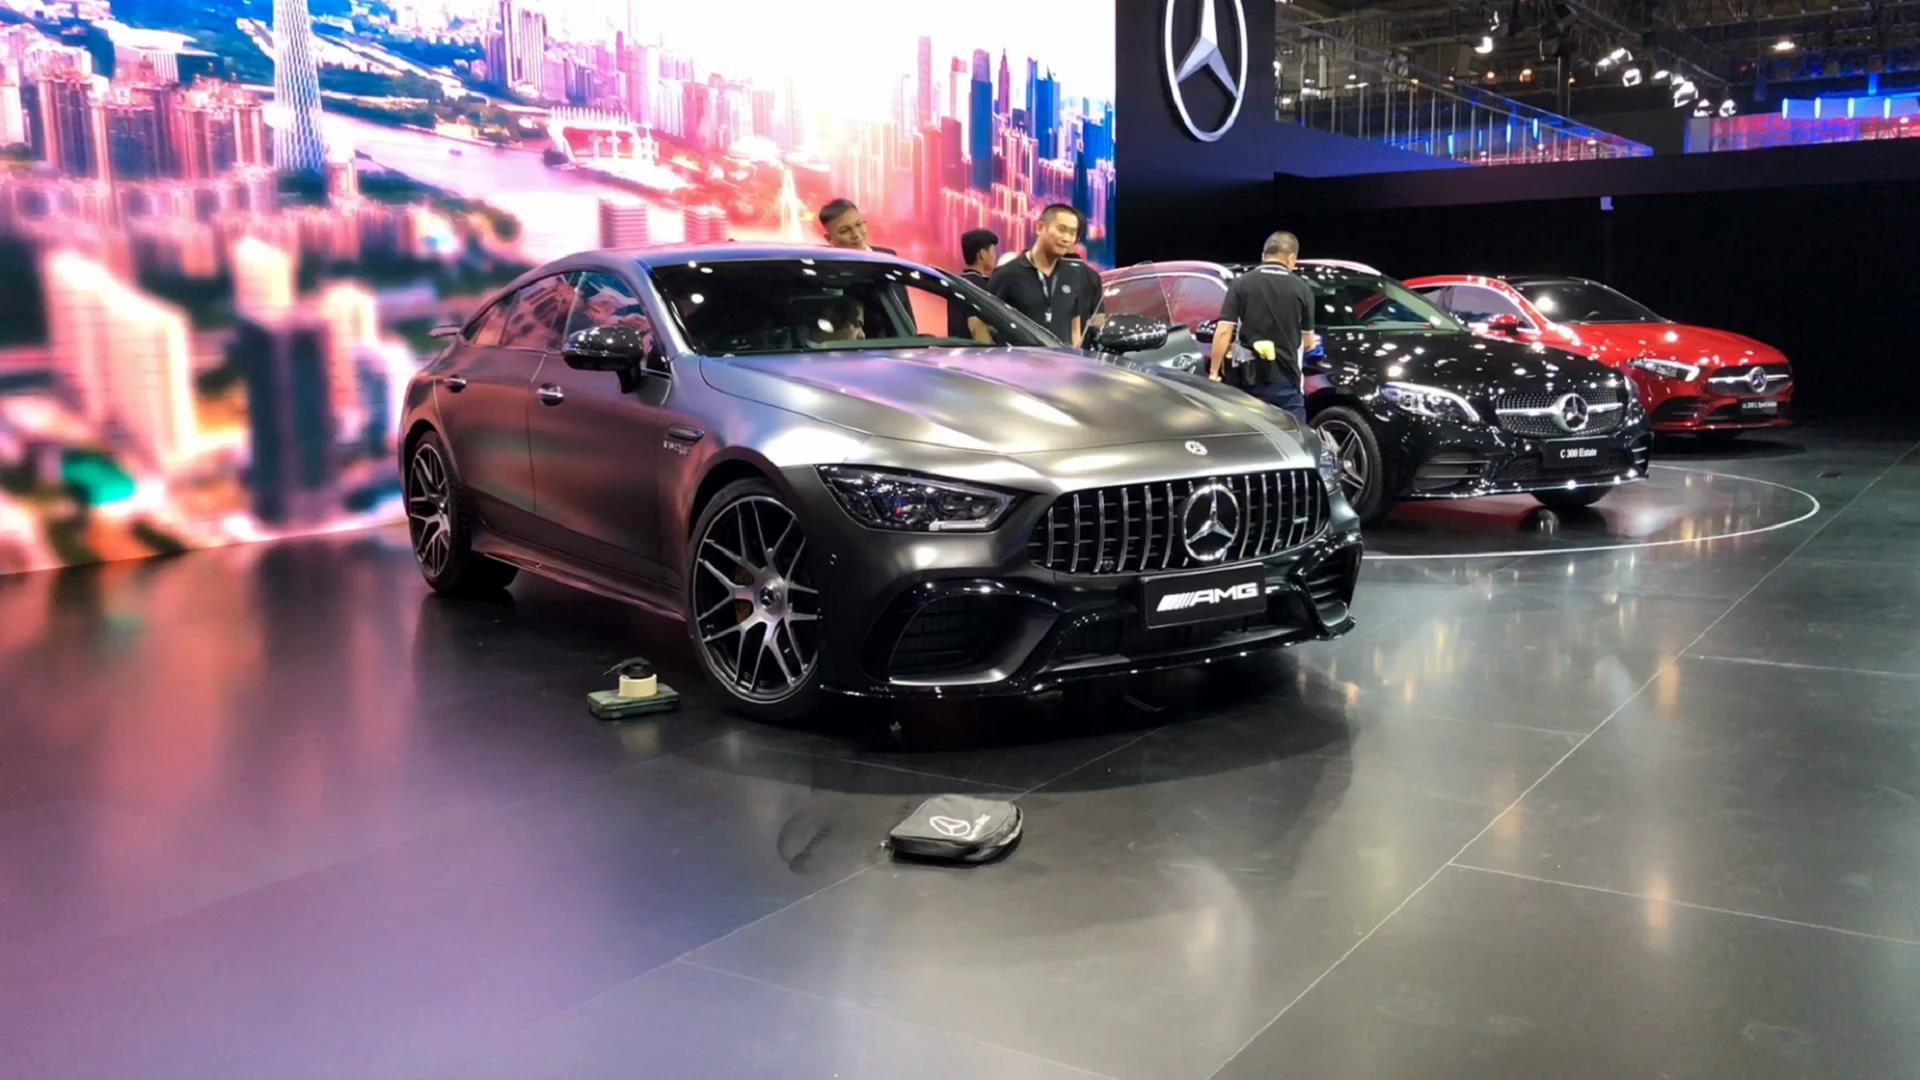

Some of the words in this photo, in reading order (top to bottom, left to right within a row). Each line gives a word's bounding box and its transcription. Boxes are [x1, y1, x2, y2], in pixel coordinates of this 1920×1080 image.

[1560, 449, 1566, 459] C
[1566, 448, 1579, 458] 300
[1189, 582, 1259, 607] AMG
